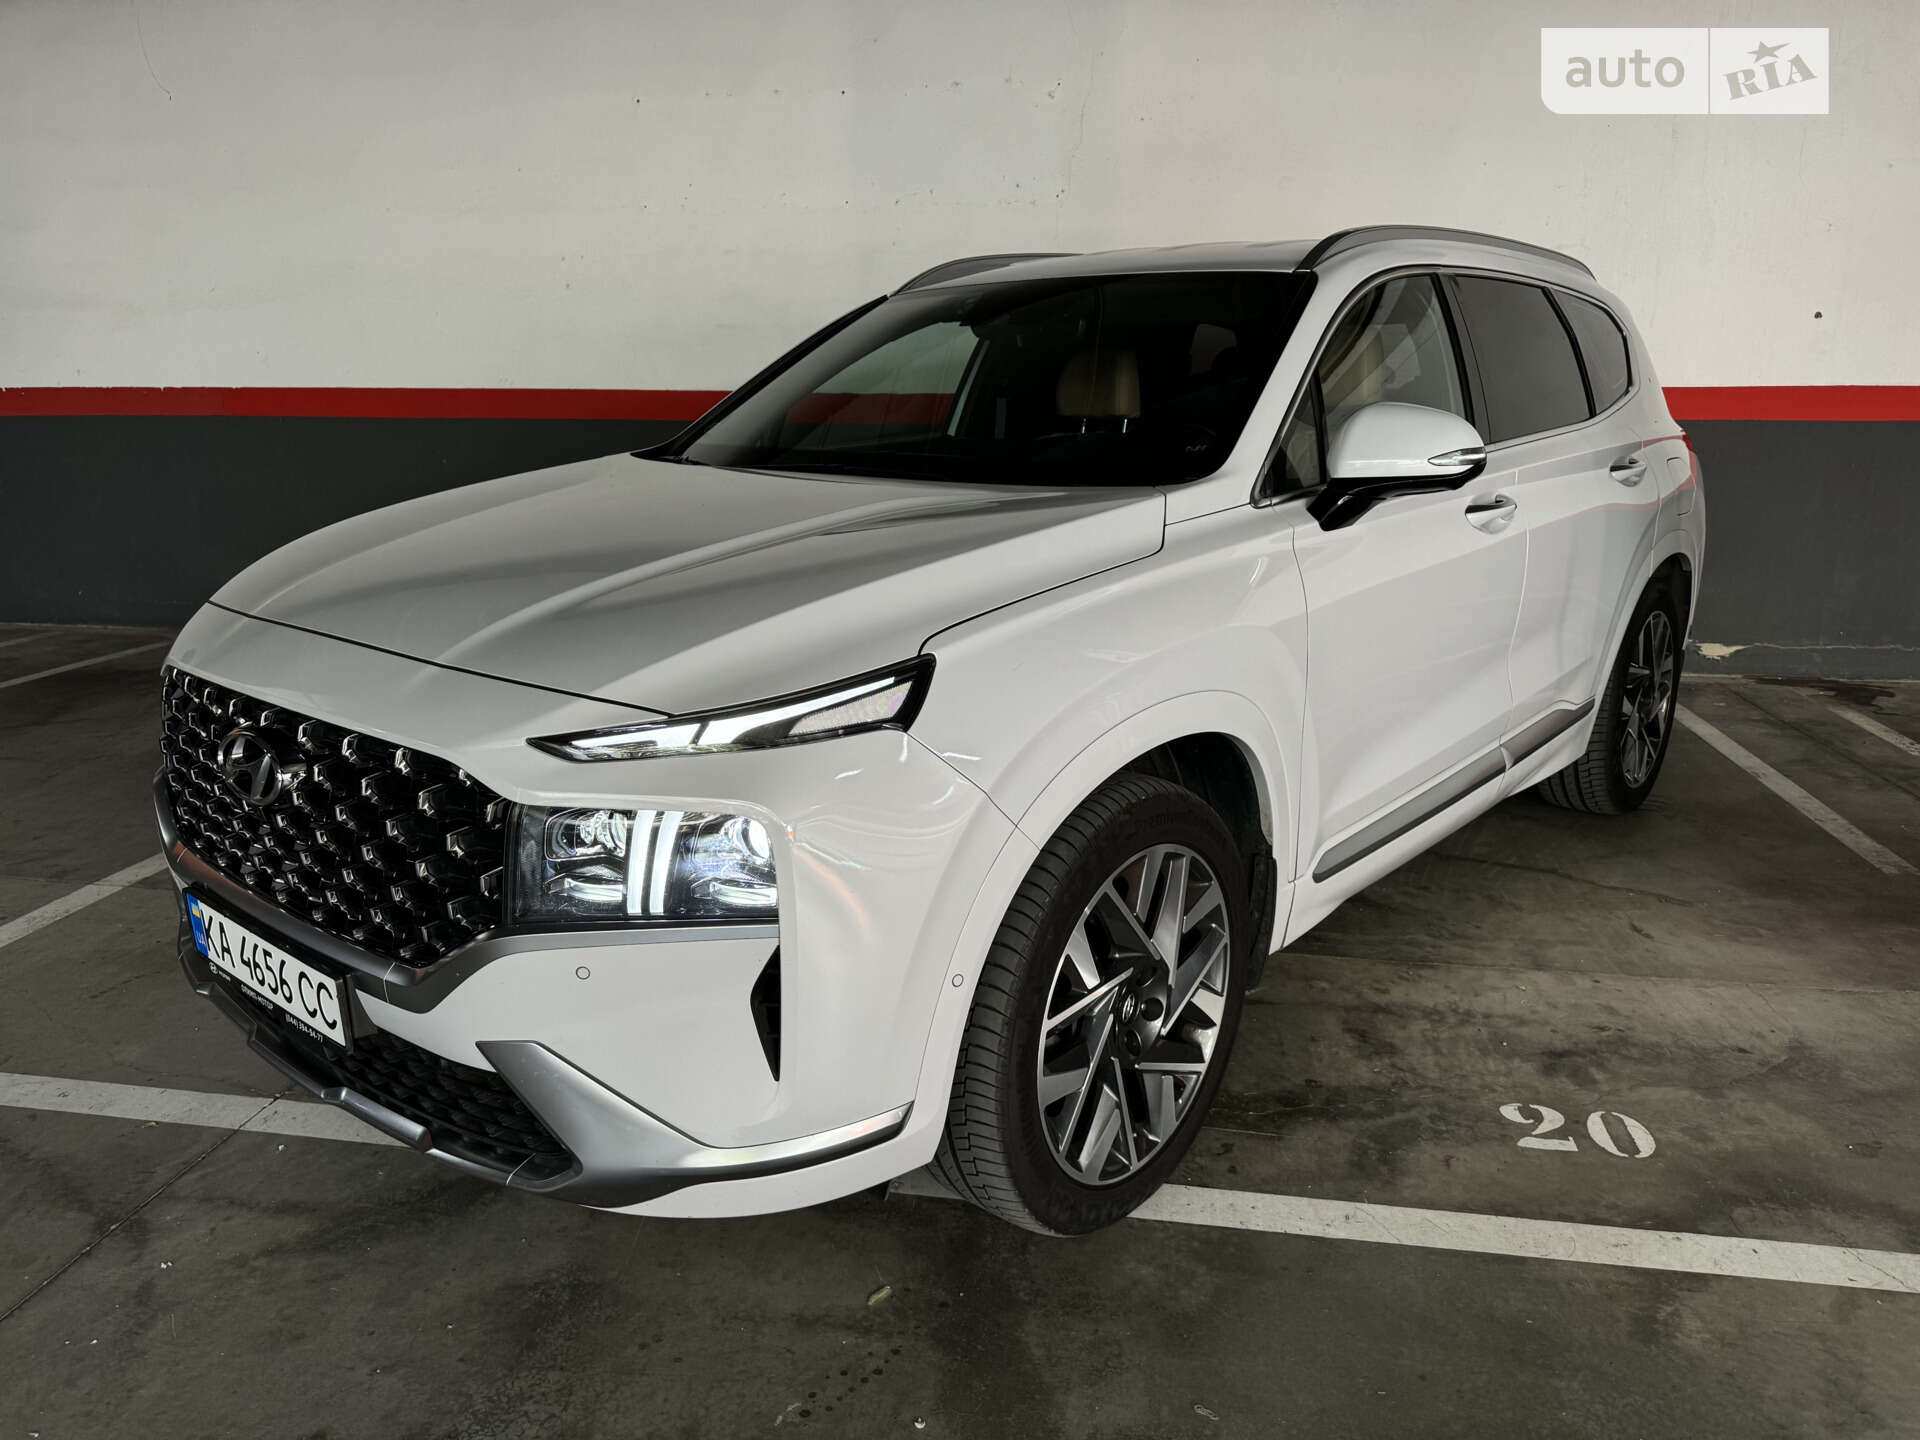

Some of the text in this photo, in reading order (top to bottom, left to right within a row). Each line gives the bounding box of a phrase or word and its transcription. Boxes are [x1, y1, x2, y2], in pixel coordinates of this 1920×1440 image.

[200, 908, 236, 969] KA
[239, 935, 293, 1005] 4656
[298, 970, 338, 1031] CC
[1499, 1102, 1656, 1159] 20
